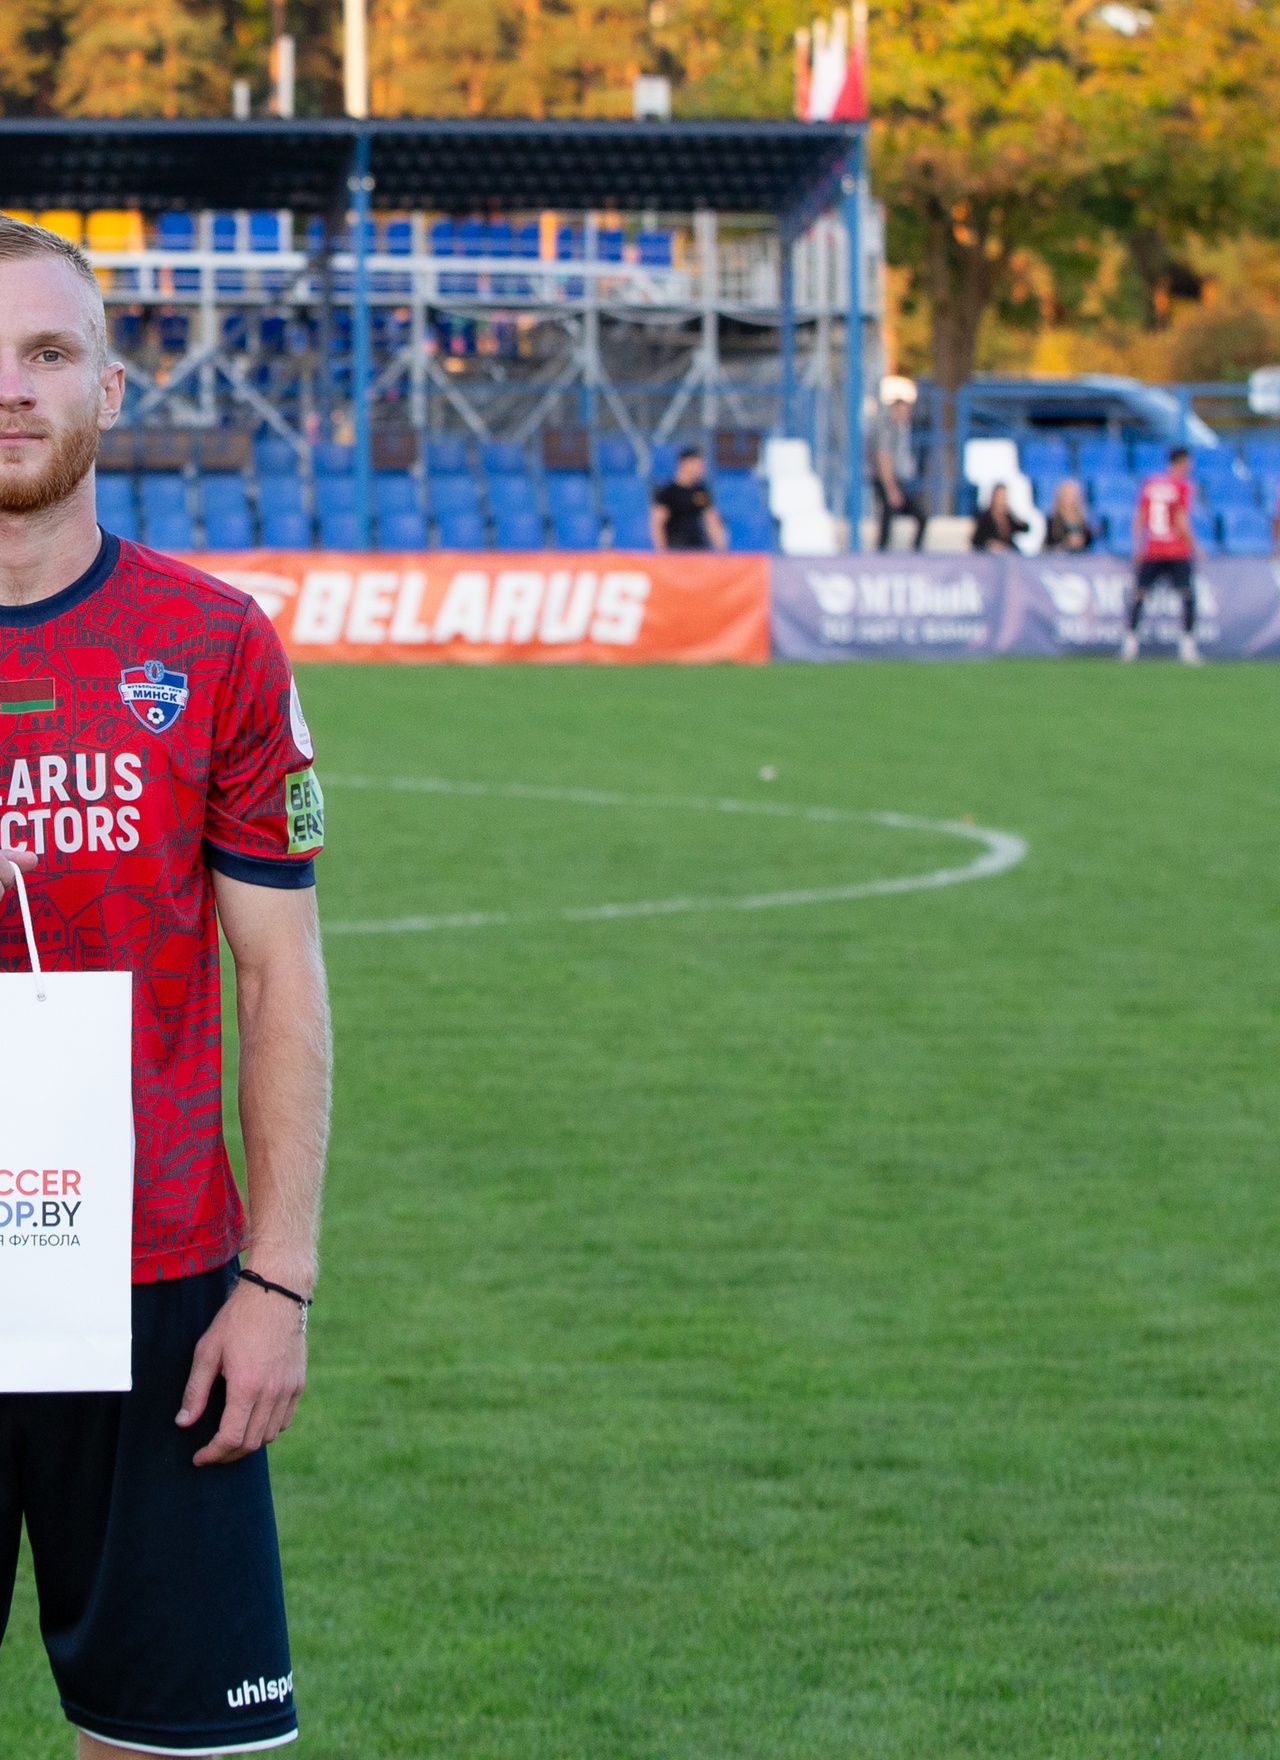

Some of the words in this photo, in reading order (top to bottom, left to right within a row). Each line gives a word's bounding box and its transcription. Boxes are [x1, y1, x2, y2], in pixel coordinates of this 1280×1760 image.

[291, 571, 651, 645] BELARUS
[133, 690, 178, 702] МИНСК
[9, 1234, 81, 1247] ФУТБОЛА
